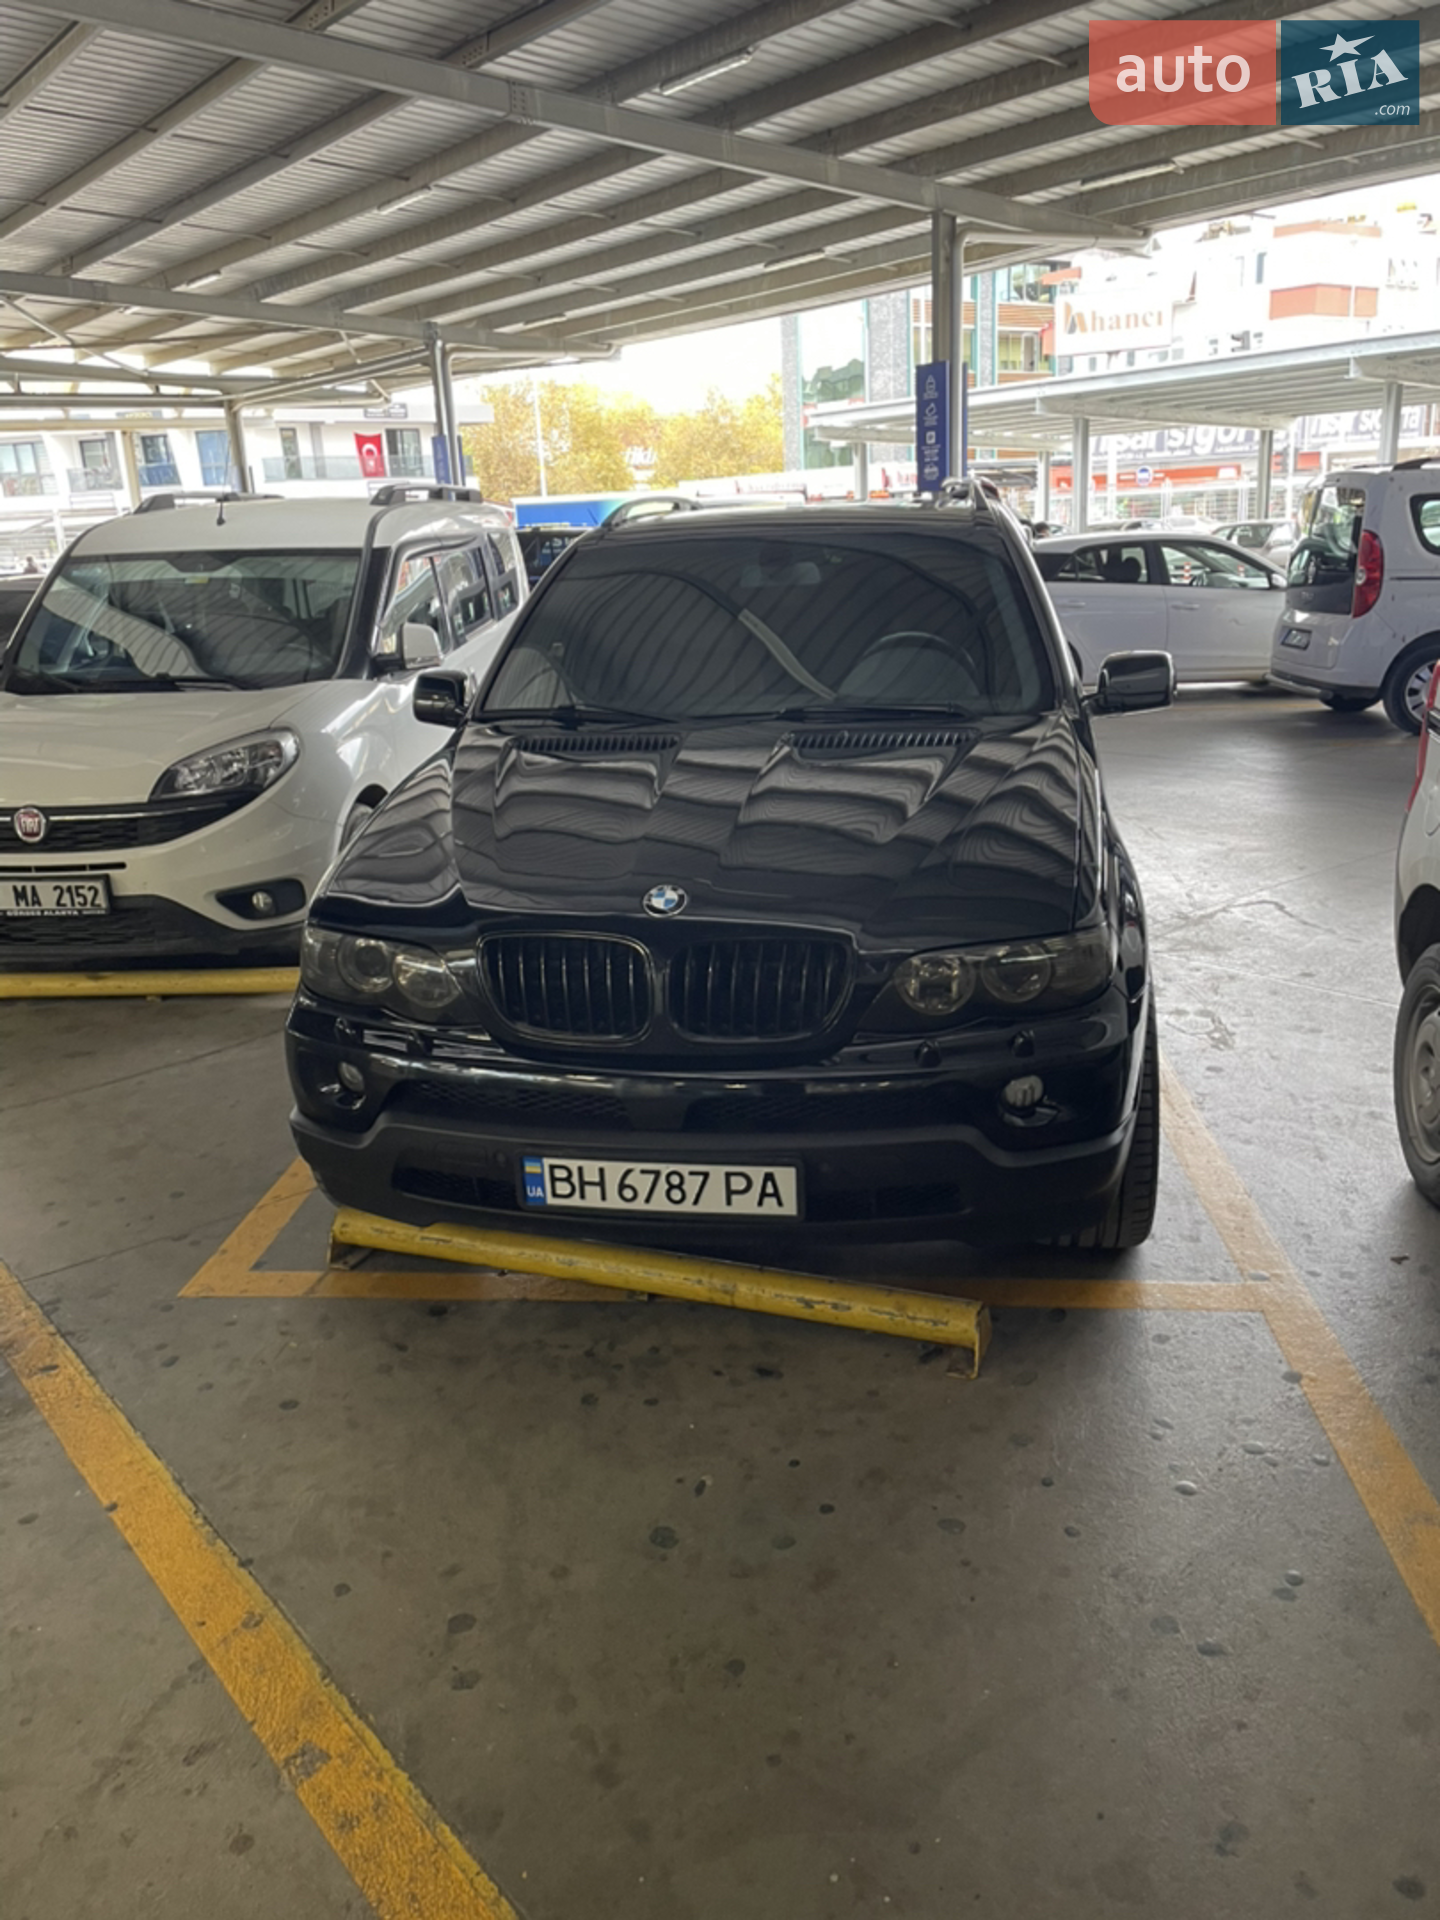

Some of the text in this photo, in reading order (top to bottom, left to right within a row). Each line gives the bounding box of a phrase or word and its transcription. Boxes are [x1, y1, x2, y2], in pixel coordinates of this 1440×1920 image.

[12, 885, 102, 907] MA 2152
[527, 1185, 545, 1199] UA
[548, 1163, 784, 1207] BH 6787 PA
